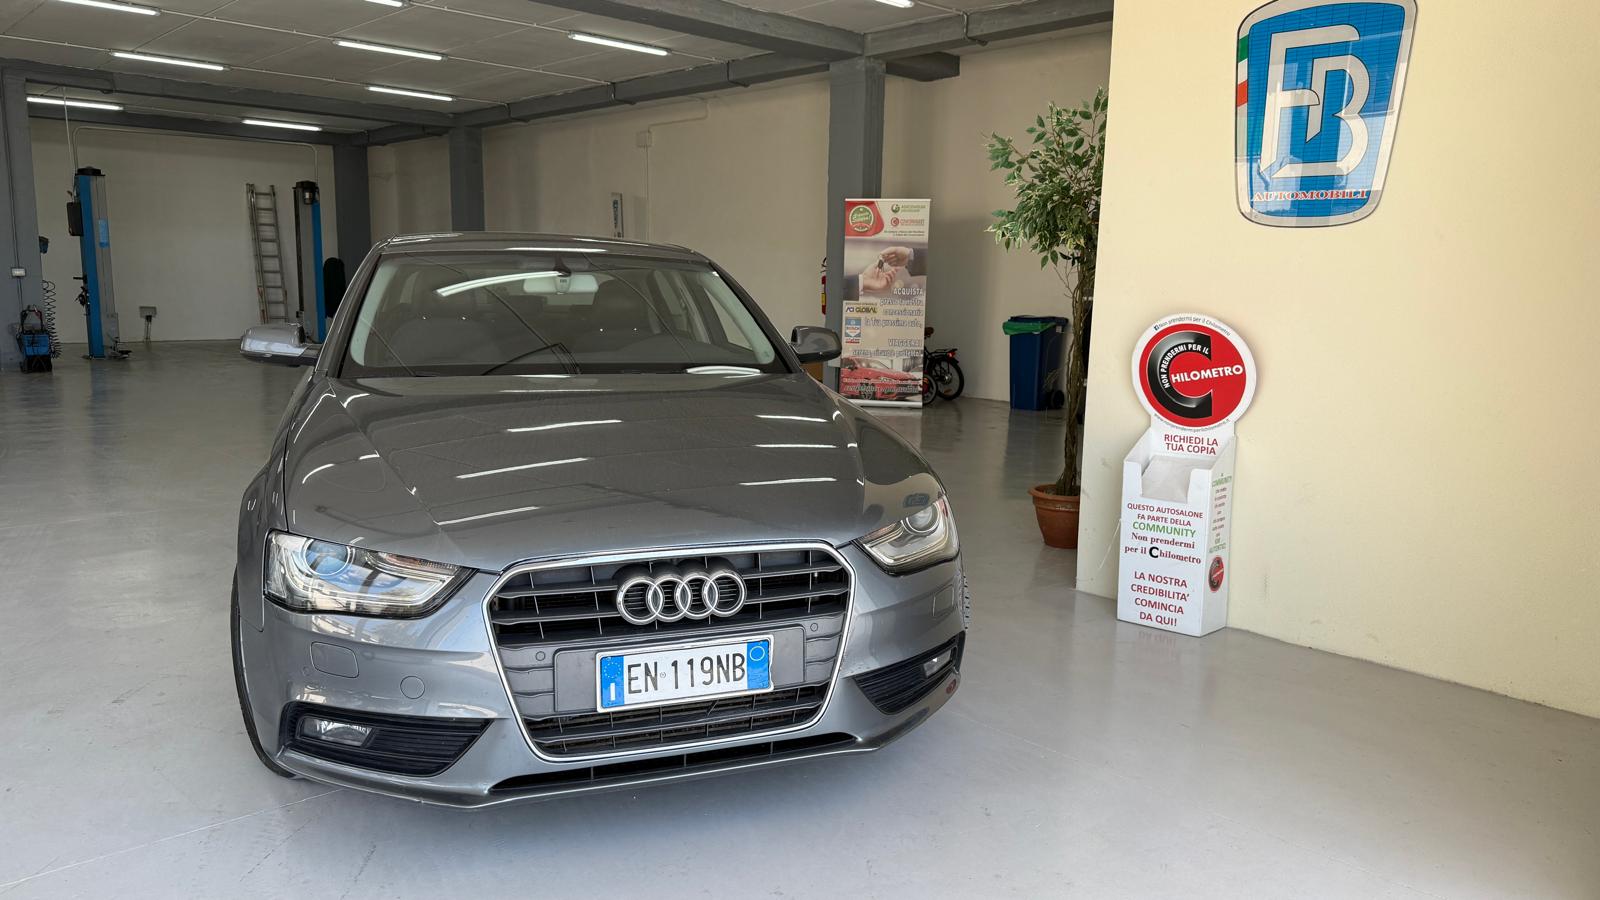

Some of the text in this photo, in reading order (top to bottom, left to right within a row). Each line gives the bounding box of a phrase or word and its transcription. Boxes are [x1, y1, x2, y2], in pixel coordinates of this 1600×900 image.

[1253, 189, 1368, 202] AUTOMOBILI
[893, 287, 923, 296] ACQUISTA
[1160, 344, 1209, 388] NON PRENDERMI PER IL
[1164, 434, 1218, 447] RICHIEDI LA
[1166, 443, 1216, 455] TUA COPIA
[1127, 502, 1203, 519] QUESTO AUTOSALONE
[1137, 513, 1192, 527] FA PARTE DELLA
[1132, 521, 1196, 538] COMMUNITY
[1131, 532, 1148, 542] Non
[1150, 536, 1195, 549] prendermi
[1124, 546, 1138, 554] per
[1140, 546, 1147, 554] il
[1149, 546, 1202, 564] Chilometro
[1134, 571, 1188, 588] LA NOSTRA
[1130, 583, 1190, 602] CREDIBILITA'
[1134, 597, 1184, 615] COMINCIA
[1139, 611, 1177, 627] DA QUI!
